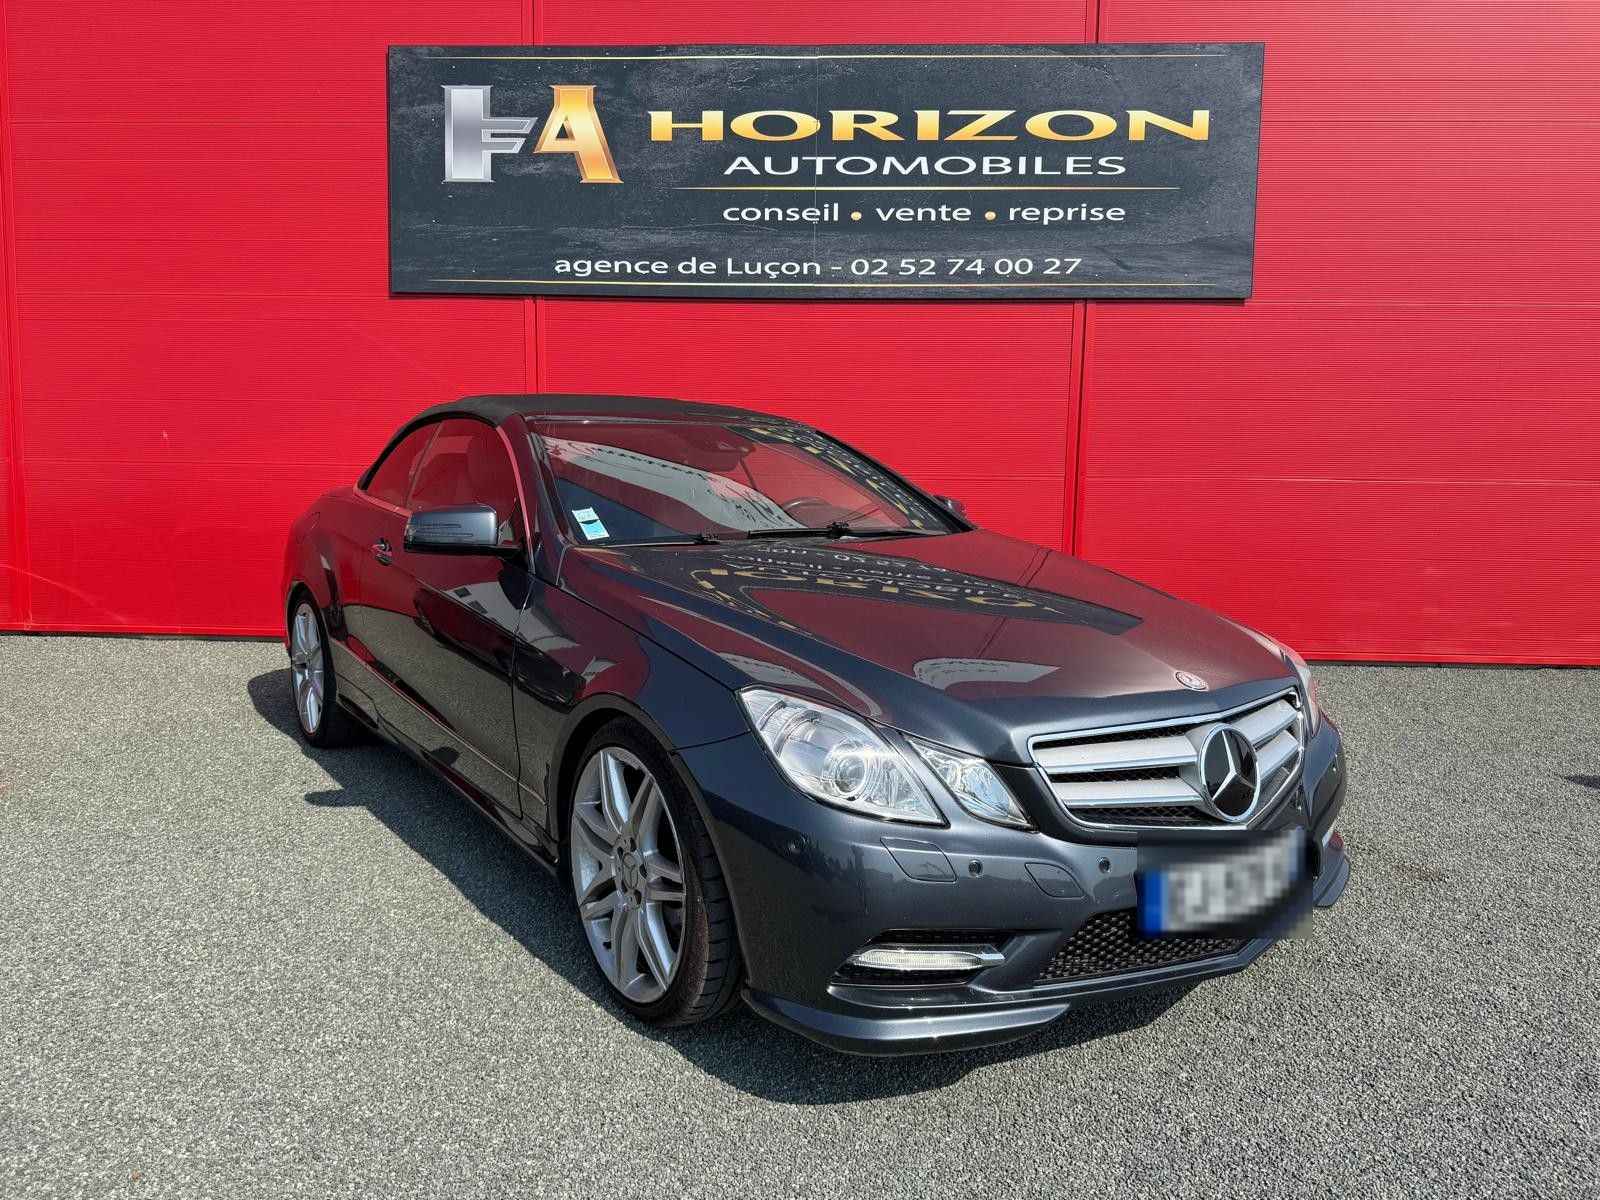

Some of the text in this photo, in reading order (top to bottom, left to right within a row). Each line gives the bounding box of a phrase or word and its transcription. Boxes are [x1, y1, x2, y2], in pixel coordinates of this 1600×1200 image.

[648, 109, 1211, 142] HORIZON
[723, 156, 1127, 176] AUTOMOBILES
[722, 202, 1126, 226] conseil vente reprise
[554, 259, 669, 277] agence
[677, 256, 717, 275] de
[727, 257, 821, 279] Luçon
[850, 258, 889, 276] 02
[898, 258, 936, 276] 52
[946, 258, 986, 275] 74
[994, 257, 1034, 275] 00
[1042, 257, 1083, 275] 27
